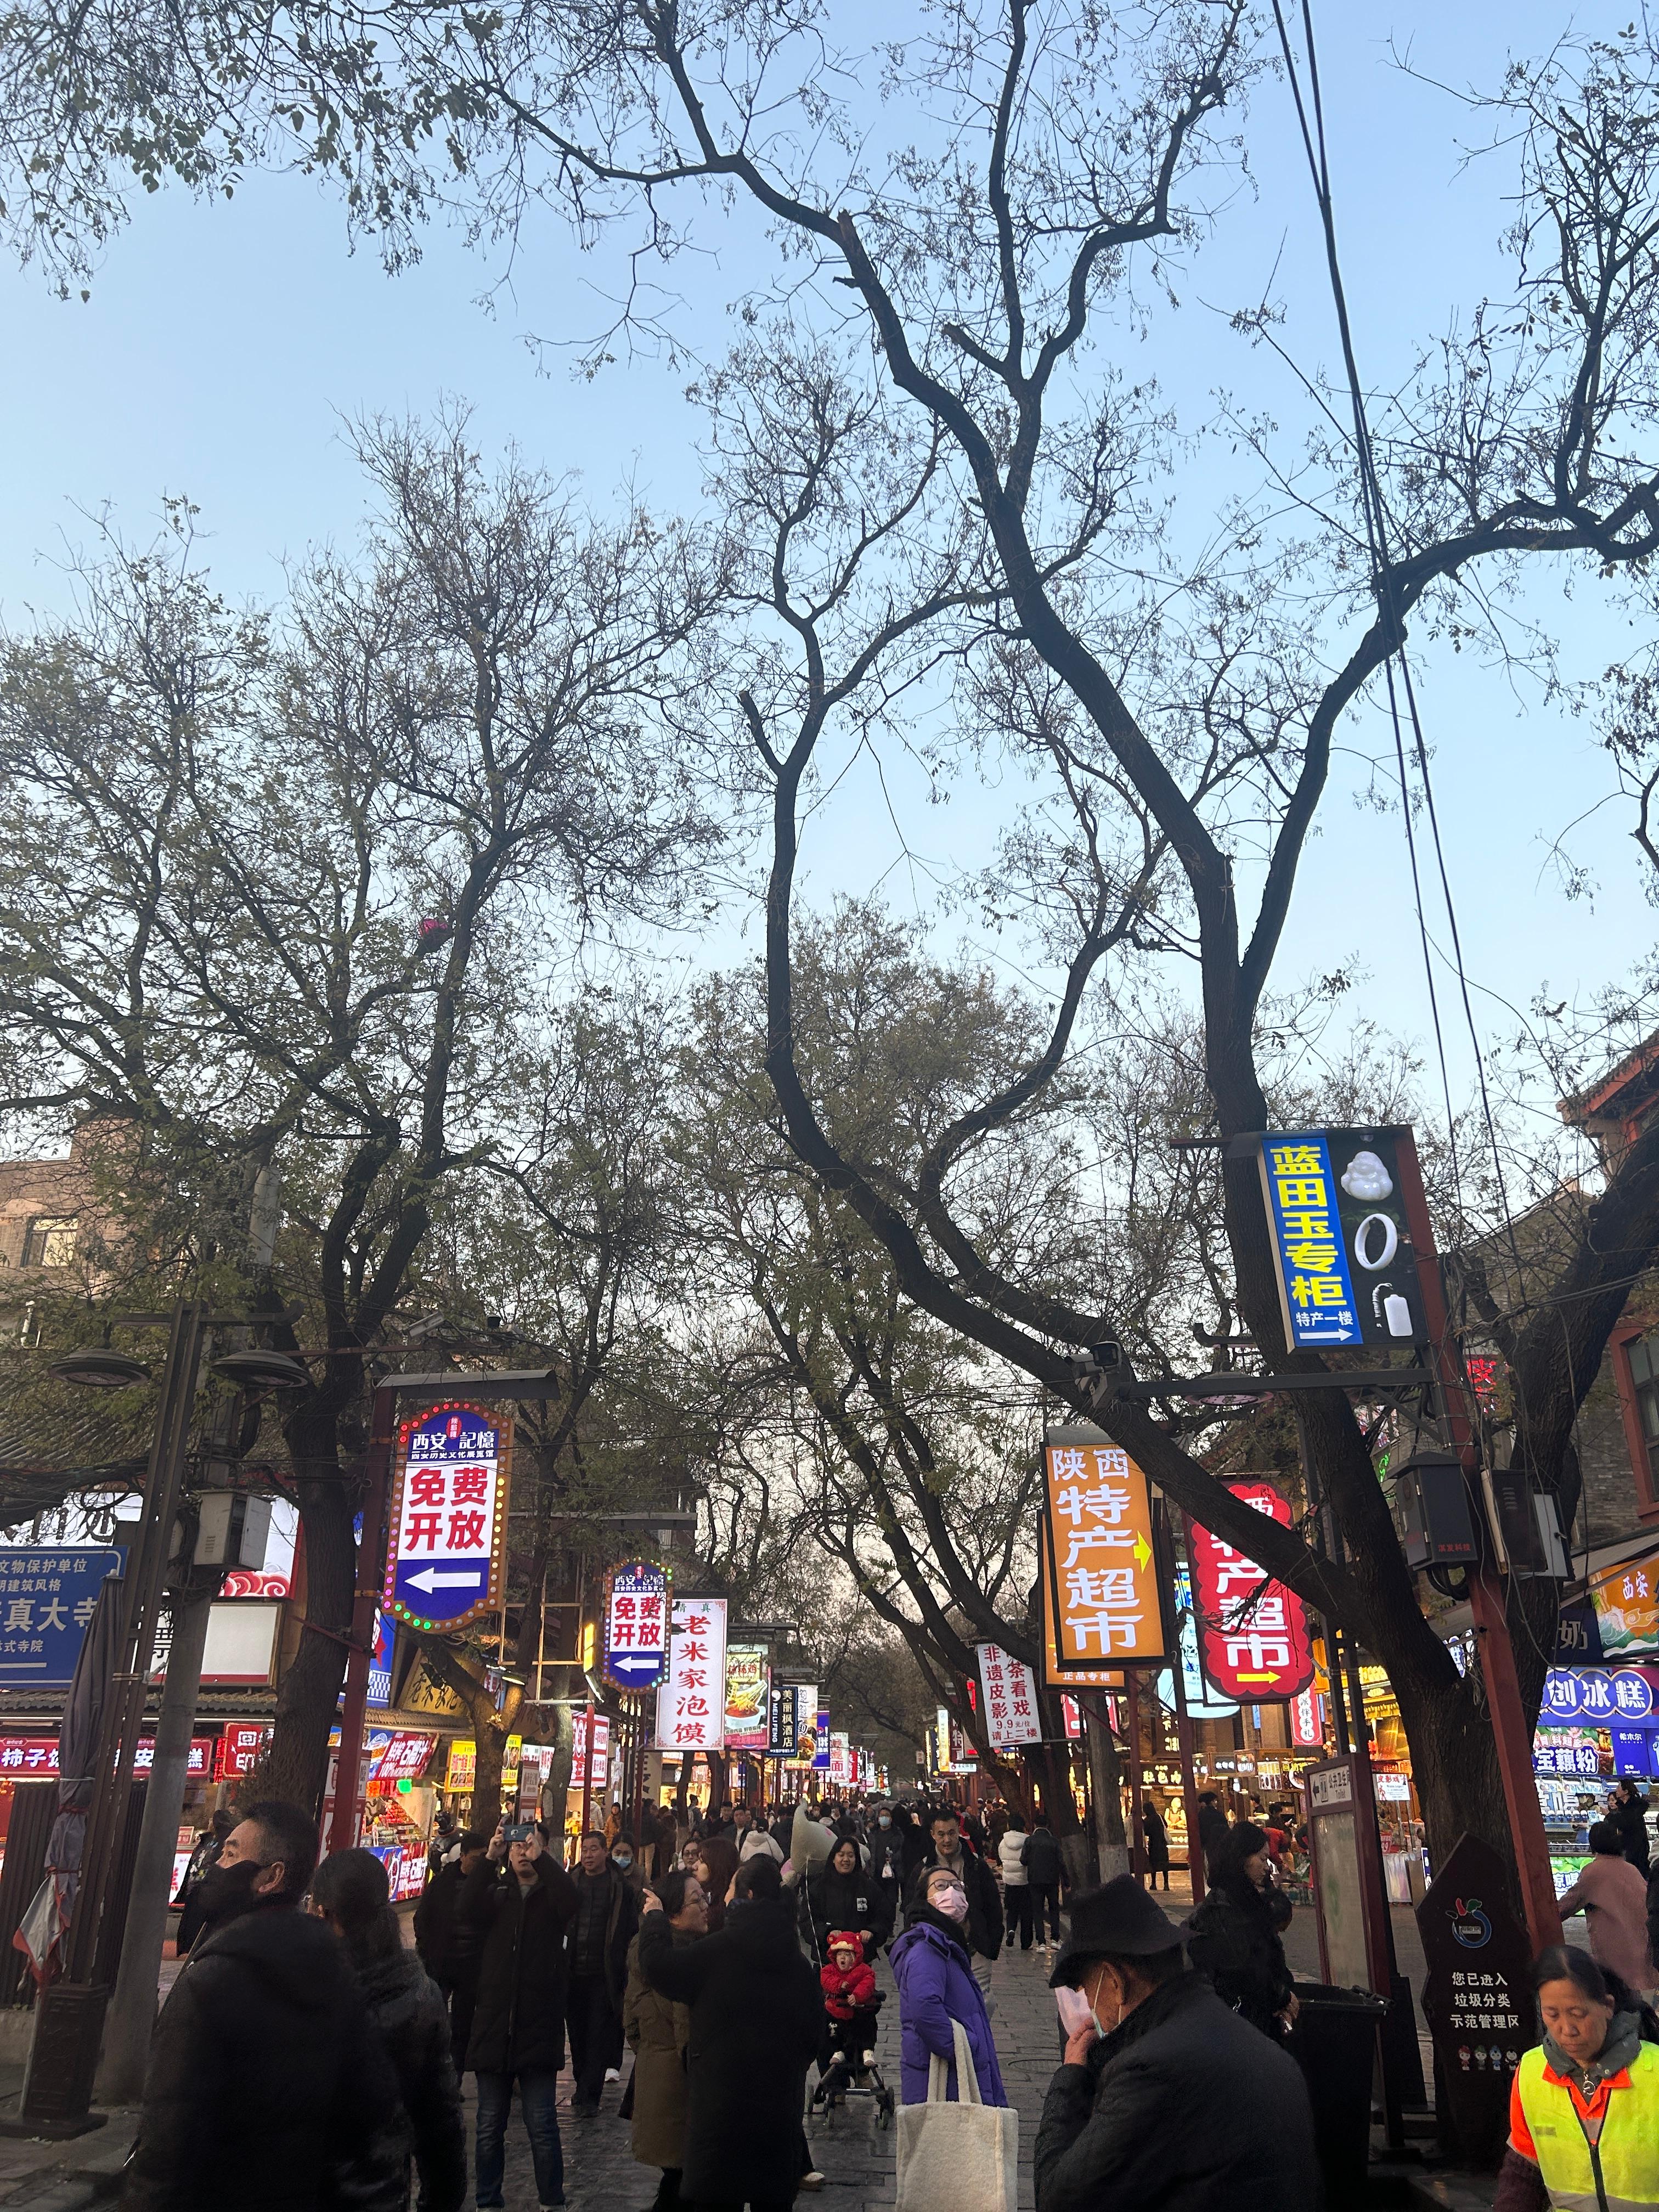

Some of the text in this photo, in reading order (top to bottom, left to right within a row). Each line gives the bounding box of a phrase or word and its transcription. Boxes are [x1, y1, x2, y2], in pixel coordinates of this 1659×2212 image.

[1269, 1146, 1347, 1308] 蓝田玉专柜
[1295, 1311, 1353, 1327] 特产一楼
[413, 1432, 447, 1451] 西安
[1052, 1448, 1129, 1482] 陕西
[409, 1468, 487, 1508] 免费
[405, 1510, 486, 1551] 开放
[0, 1558, 88, 1573] 文物保护单位
[1056, 1483, 1144, 1656] 特产超市
[615, 1575, 635, 1587] 西安
[1622, 1571, 1648, 1600] 西安
[0, 1596, 98, 1633] 真大寺
[614, 1596, 661, 1620] 免费
[613, 1623, 660, 1647] 开放
[671, 1615, 712, 1745] 老米家泡馍
[983, 1645, 1008, 1719] 非遗皮影
[1006, 1652, 1031, 1717] 茶看戏
[1063, 1672, 1110, 1682] 正品专柜
[1547, 1679, 1646, 1708] 创冰糕
[991, 1727, 1038, 1741] 请上二楼
[996, 1719, 1013, 1730] 9.9
[1533, 1748, 1598, 1773] 宝藕粉
[1452, 1972, 1508, 1987] 您已进入
[1454, 1993, 1510, 2008] 垃圾分类
[1449, 2014, 1520, 2029] 示范管理区
